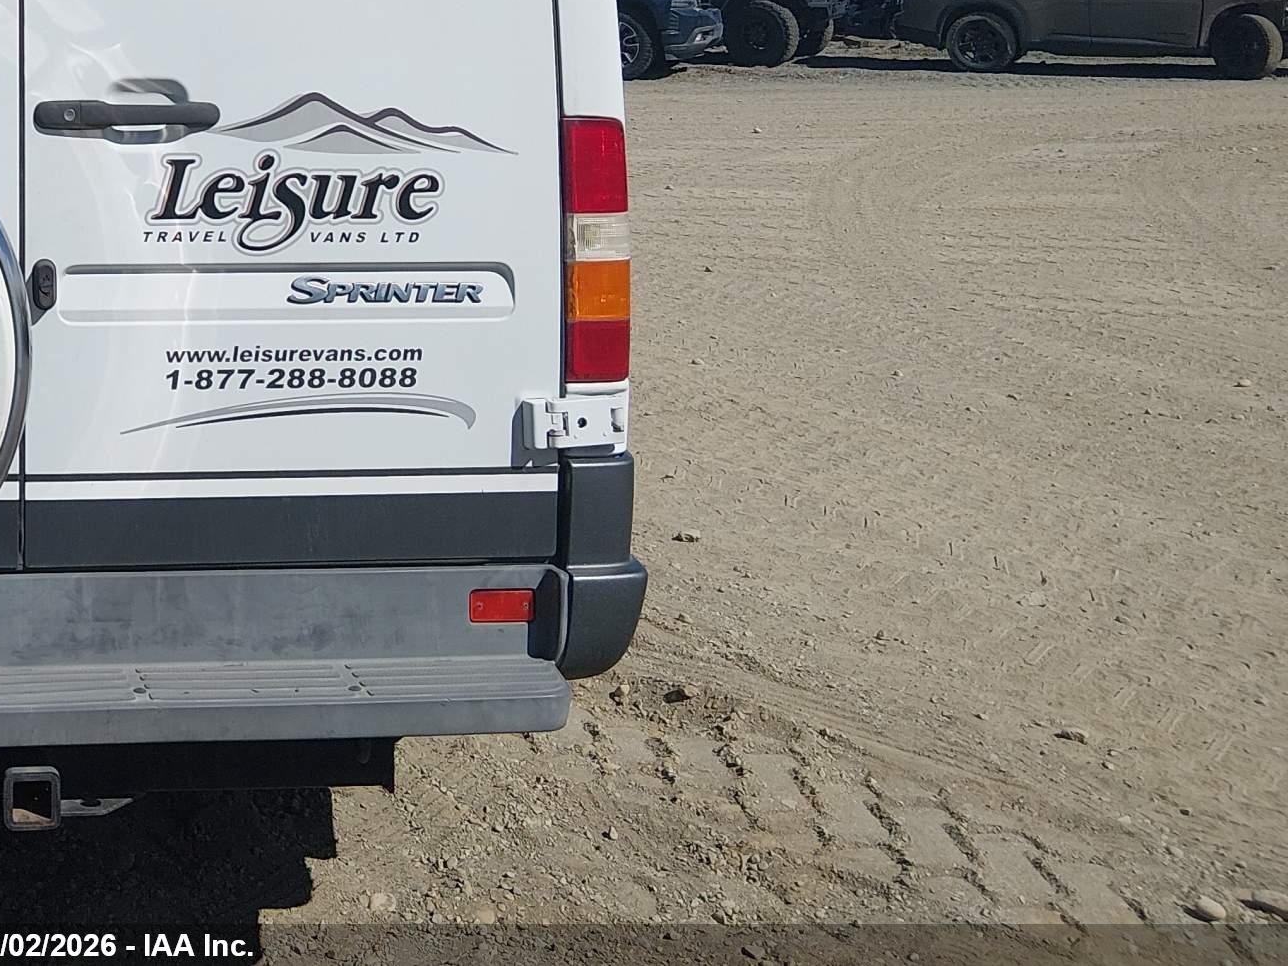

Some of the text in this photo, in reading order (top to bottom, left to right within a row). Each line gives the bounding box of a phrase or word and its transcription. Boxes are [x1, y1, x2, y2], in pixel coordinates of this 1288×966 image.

[150, 154, 441, 252] Leisure
[143, 231, 420, 243] TRAVEL VANS LTD
[286, 275, 484, 305] SPRINTER
[166, 345, 423, 364] www.leisurevans.com
[166, 367, 418, 390] 1-877-288-8088
